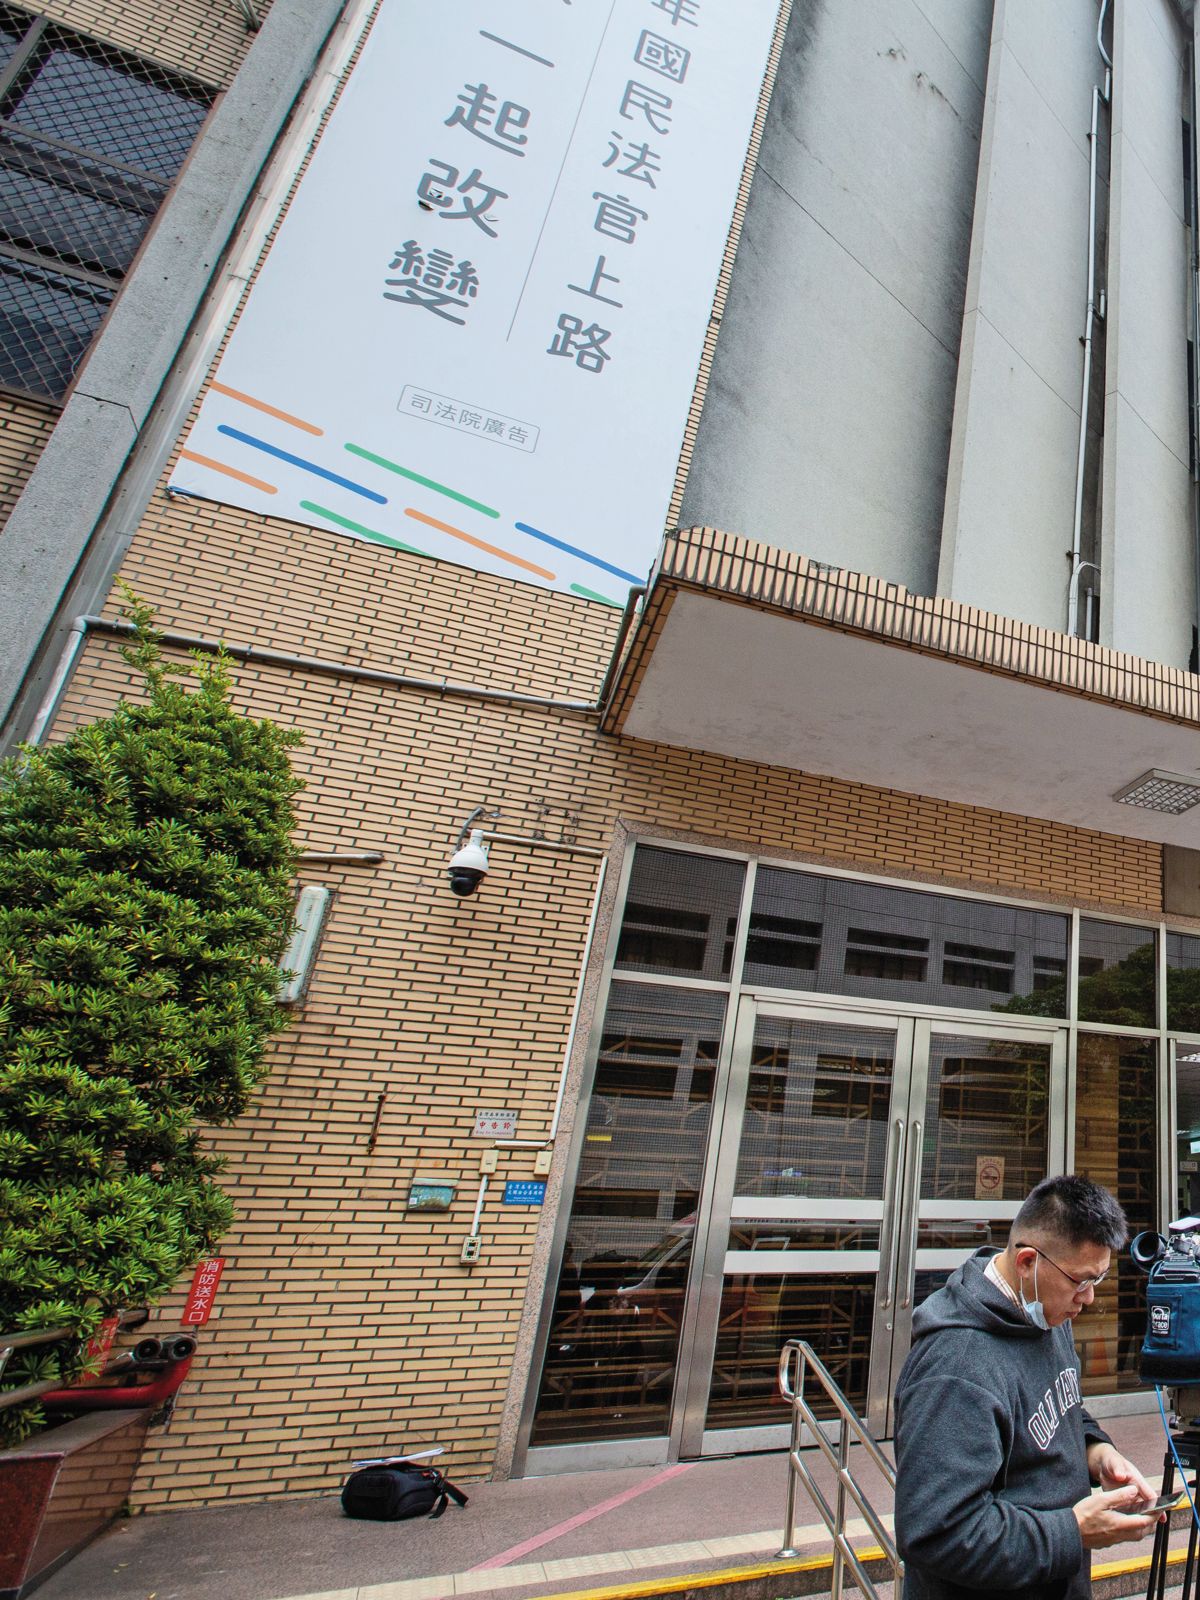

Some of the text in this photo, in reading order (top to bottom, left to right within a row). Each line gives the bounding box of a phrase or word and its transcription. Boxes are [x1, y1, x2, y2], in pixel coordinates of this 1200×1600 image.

[383, 30, 555, 325] 一起改變
[411, 393, 529, 444] 司法院廣告
[188, 1261, 220, 1322] 消防送水口
